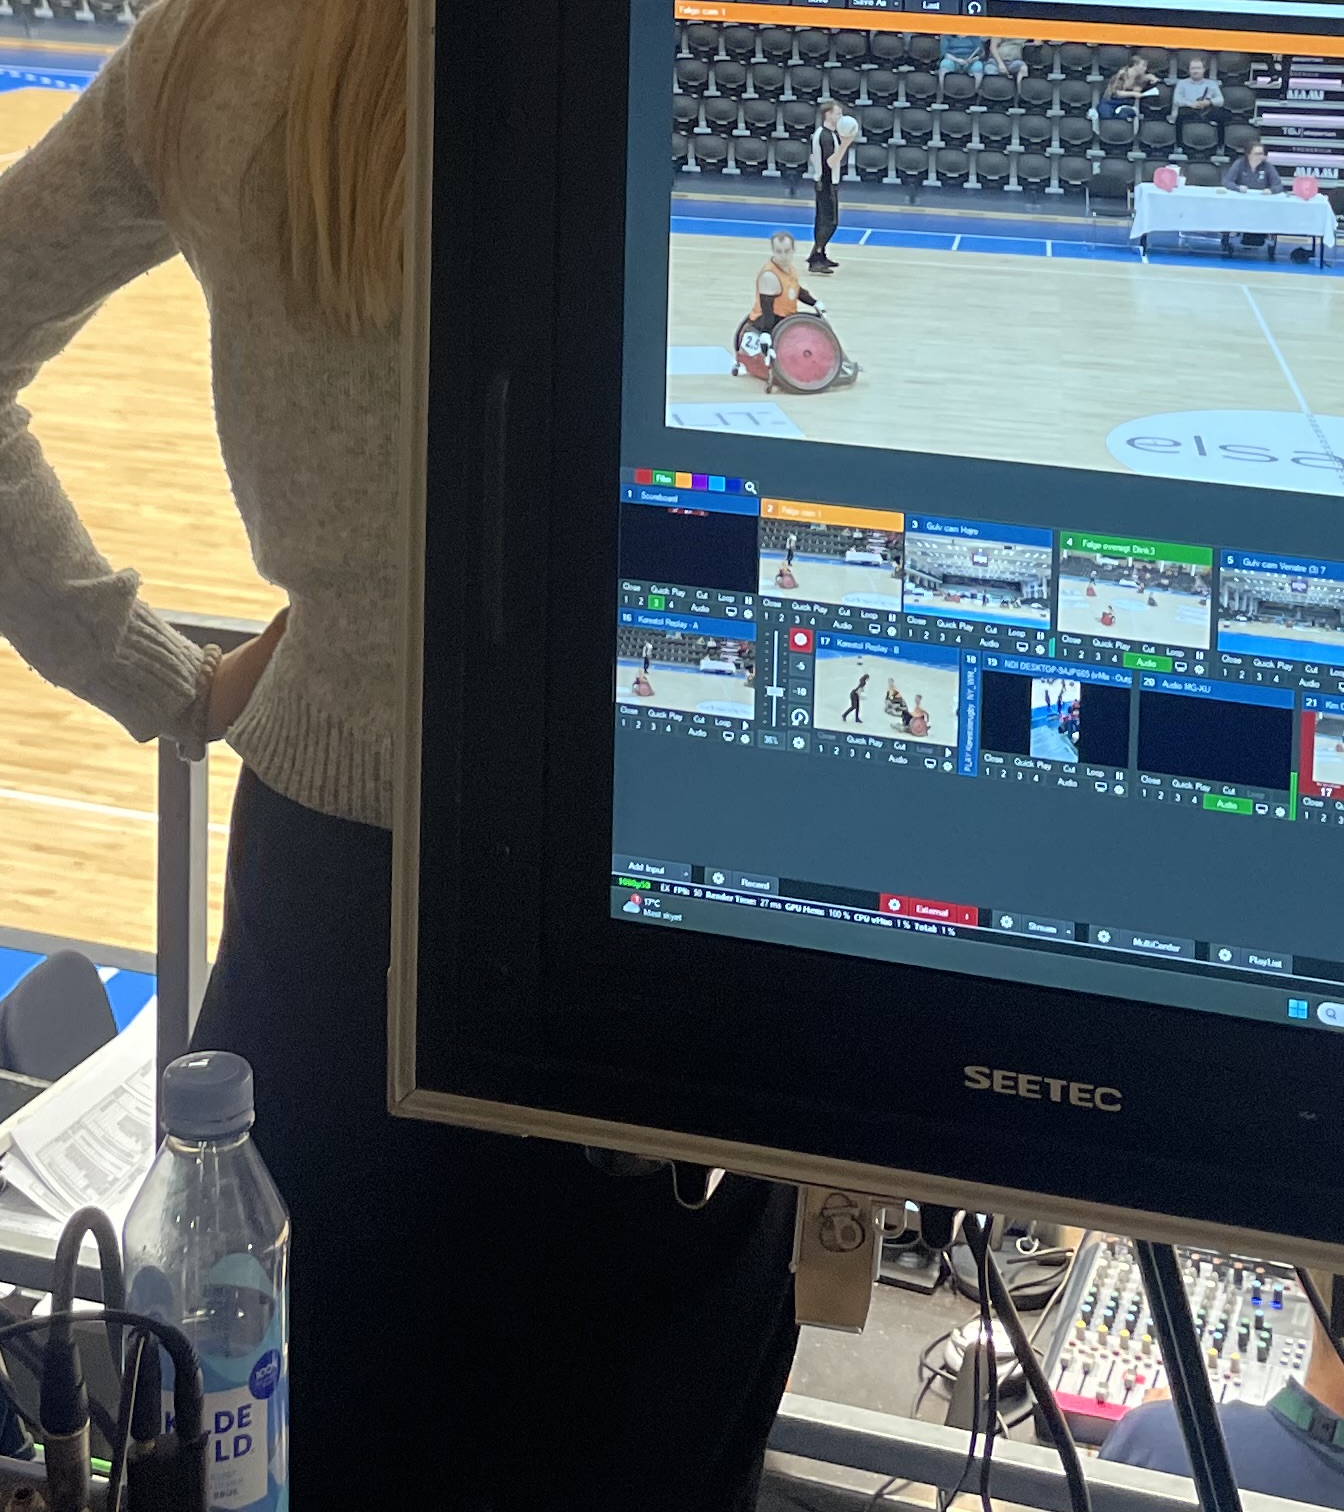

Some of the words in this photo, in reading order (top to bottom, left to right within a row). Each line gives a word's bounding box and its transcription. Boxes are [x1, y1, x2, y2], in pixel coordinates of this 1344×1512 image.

[922, 0, 941, 10] Last
[622, 613, 632, 622] 16
[820, 636, 830, 646] 17
[1136, 657, 1157, 668] Audio
[1144, 677, 1155, 687] 20
[1306, 697, 1318, 708] 21
[1216, 799, 1238, 810] Audio
[629, 862, 644, 872] Add
[646, 864, 665, 875] Input
[741, 878, 770, 891] Record
[916, 902, 949, 919] External
[1028, 921, 1057, 935] Stream
[964, 1065, 1123, 1112] SEETEC
[166, 1404, 252, 1434] KDE
